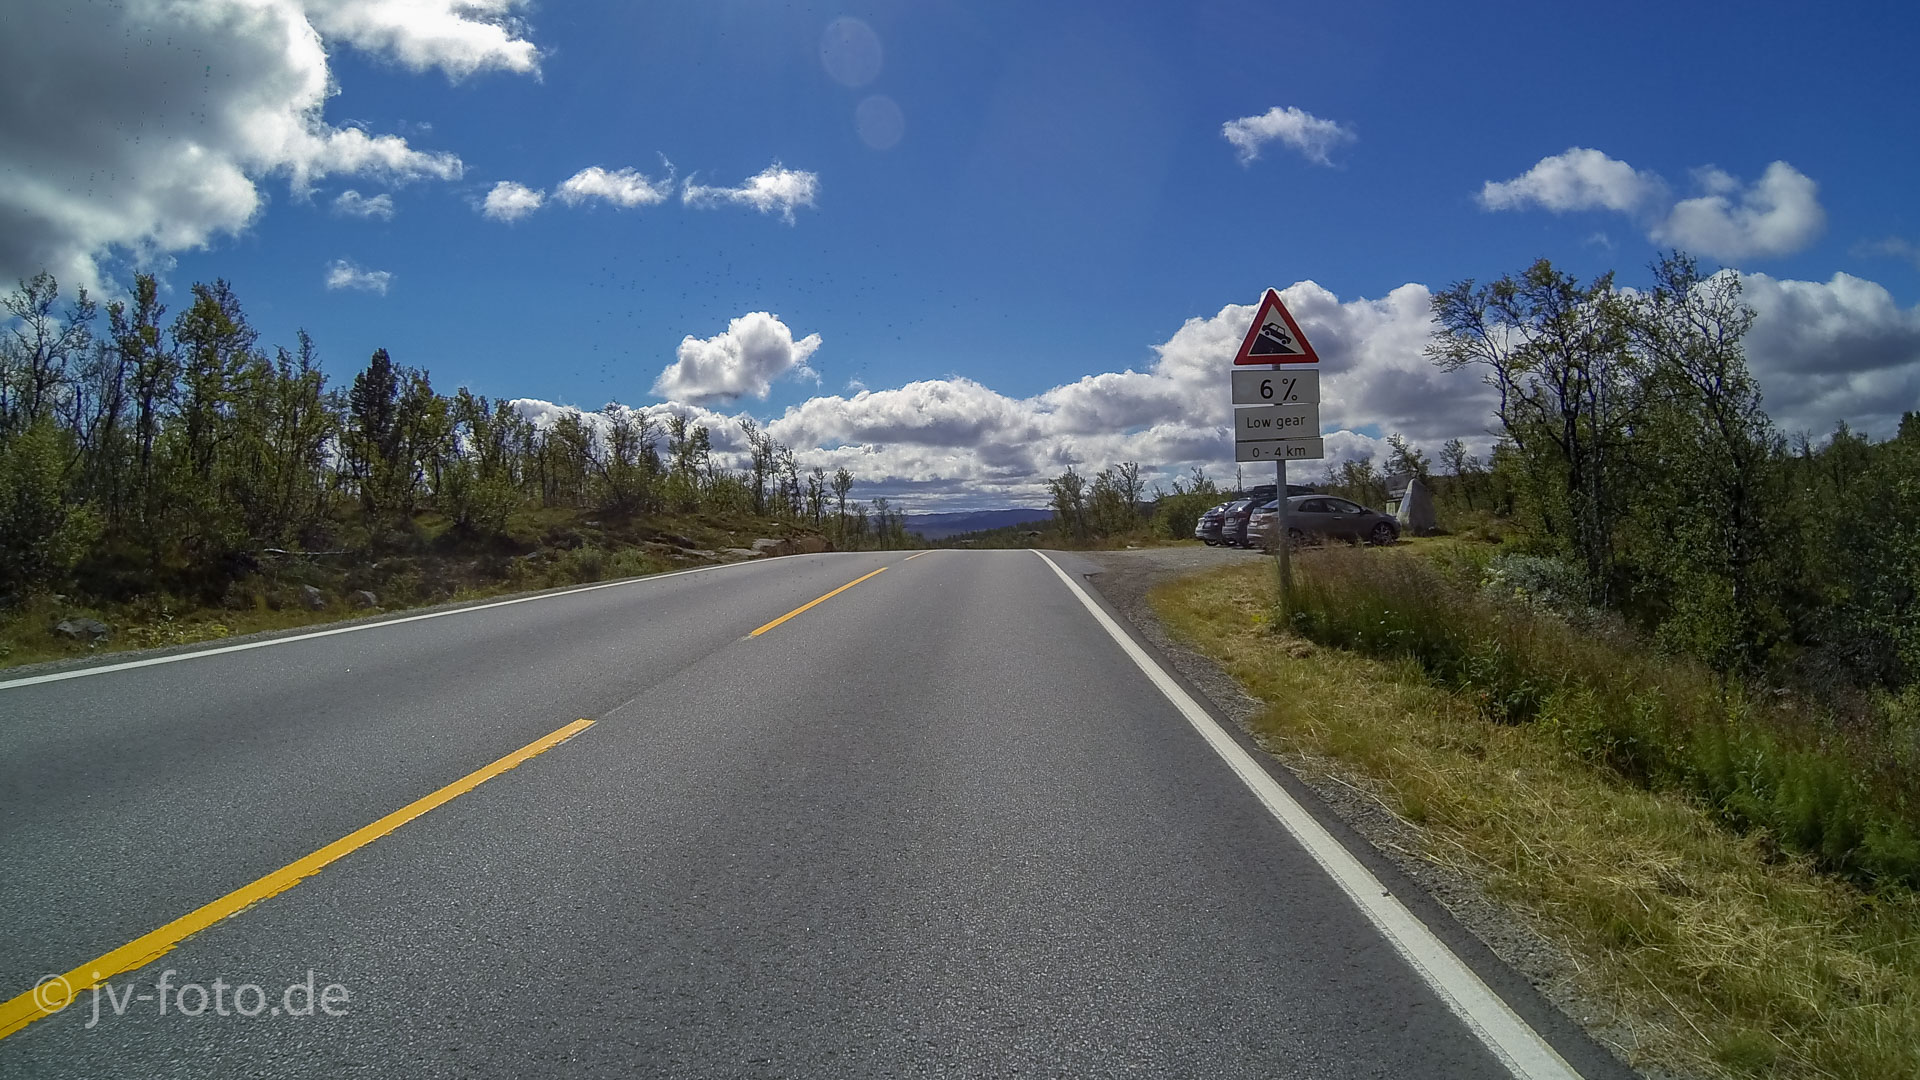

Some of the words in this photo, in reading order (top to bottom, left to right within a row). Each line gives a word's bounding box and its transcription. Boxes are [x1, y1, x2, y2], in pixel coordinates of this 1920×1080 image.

[1260, 379, 1274, 399] 6
[1282, 378, 1298, 401] %
[1247, 417, 1272, 429] Low
[1276, 416, 1306, 430] gear
[1252, 447, 1260, 458] 0
[1274, 446, 1282, 457] 4
[1286, 445, 1306, 457] km
